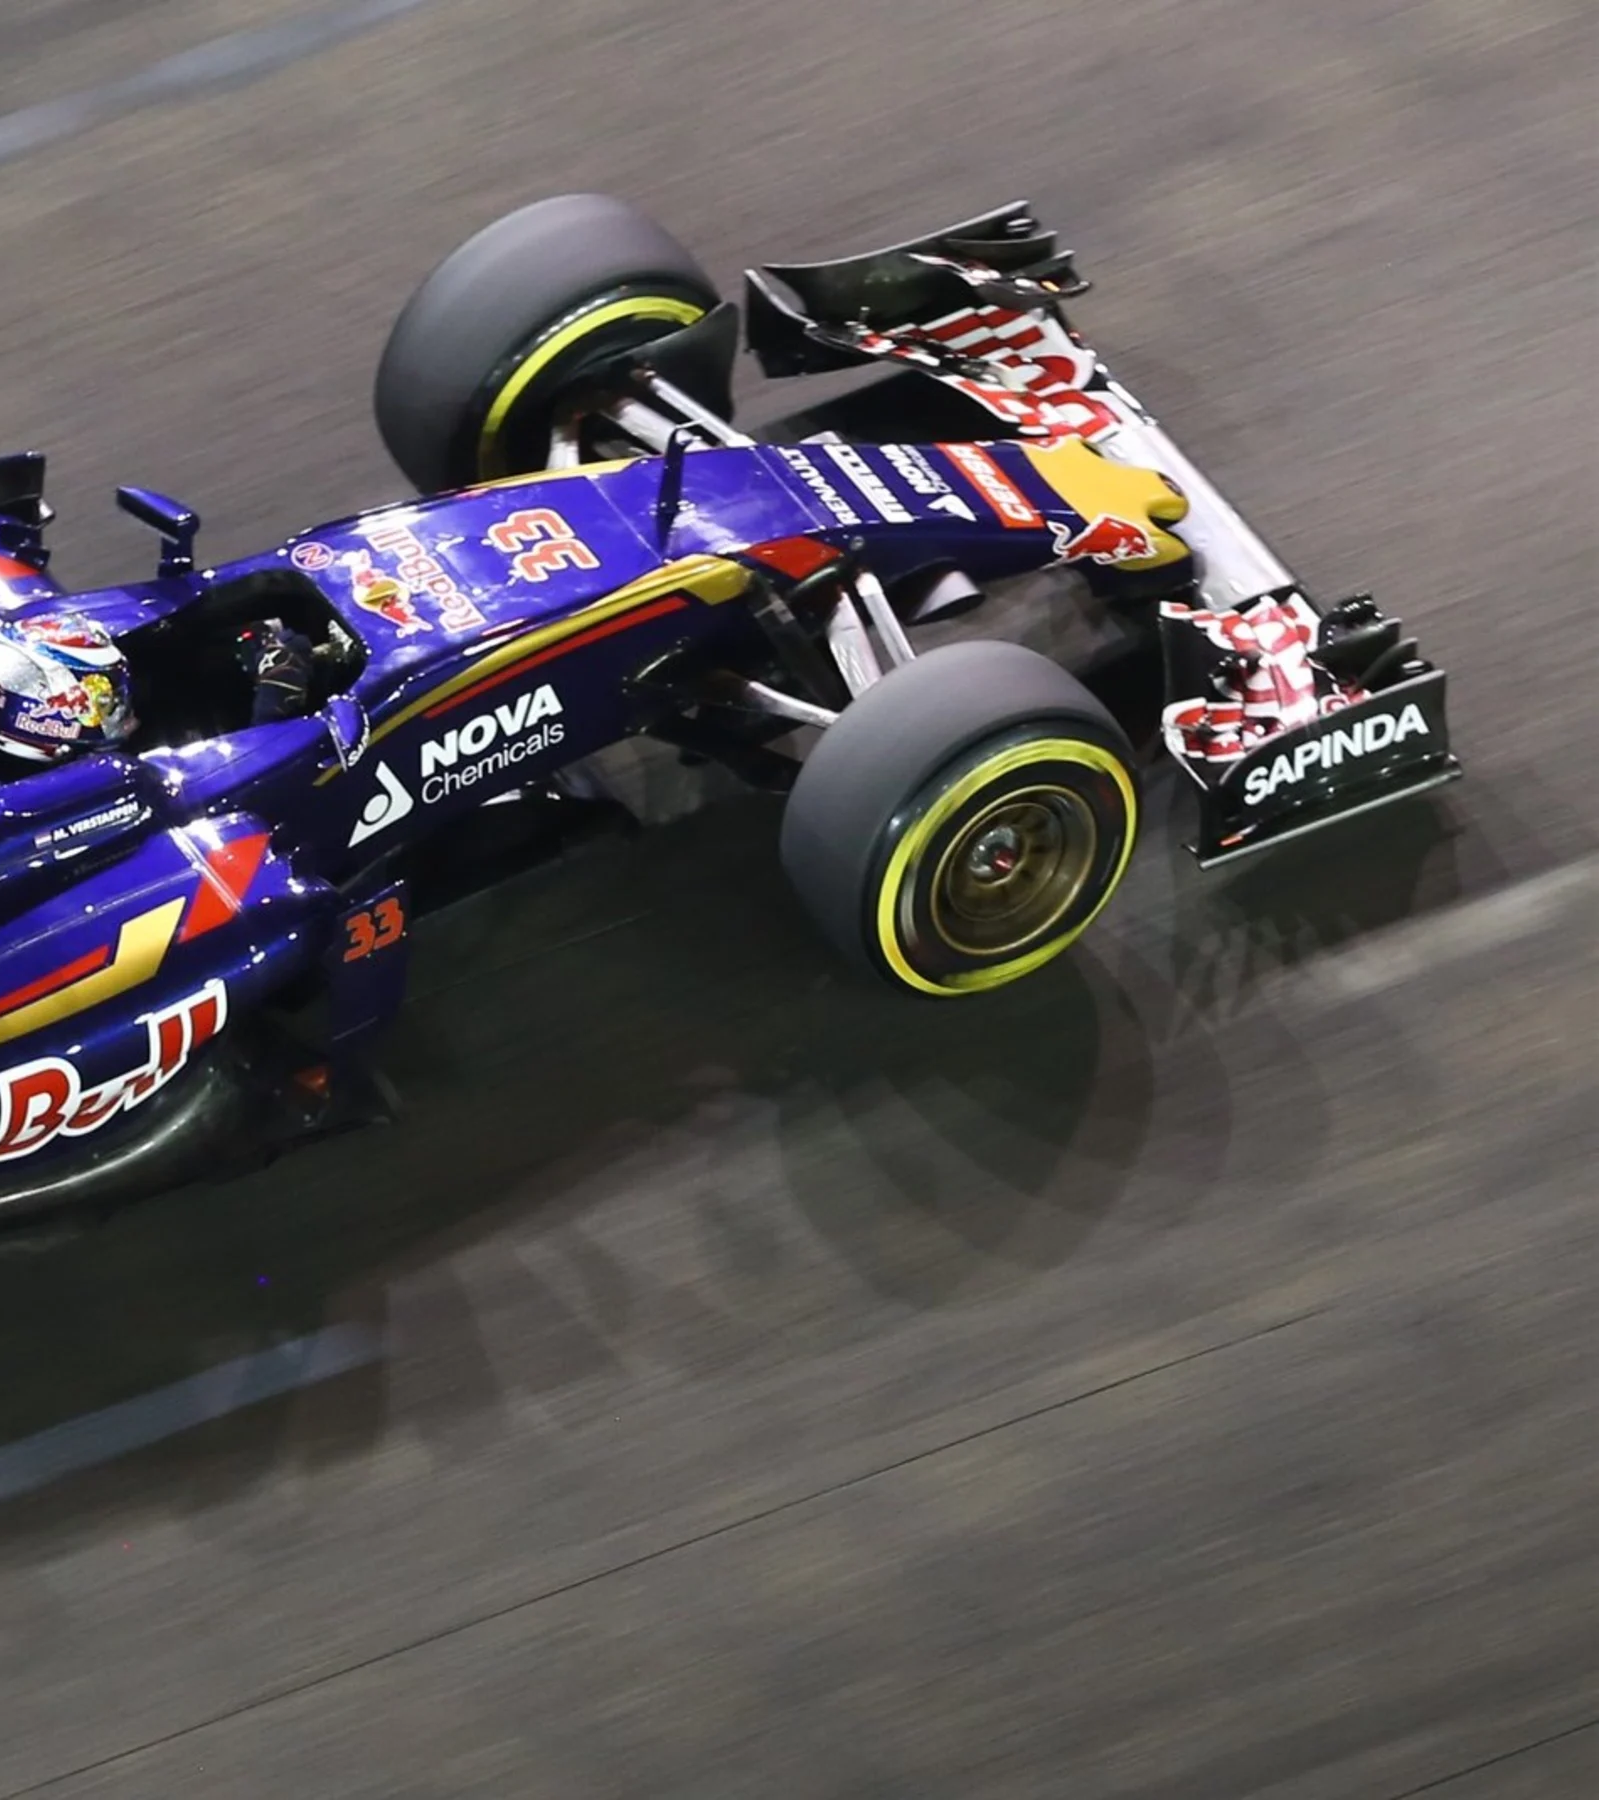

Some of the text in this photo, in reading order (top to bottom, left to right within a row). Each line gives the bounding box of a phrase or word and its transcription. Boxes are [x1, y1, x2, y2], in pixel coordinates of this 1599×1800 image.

[777, 446, 862, 525] RENAULT
[879, 443, 937, 494] NOVA
[946, 443, 1034, 522] CEPSA
[489, 507, 601, 582] 33
[420, 683, 564, 778] NOVA
[421, 722, 565, 805] Chemicals
[1243, 703, 1430, 806] SAPINDA
[343, 897, 405, 963] 33
